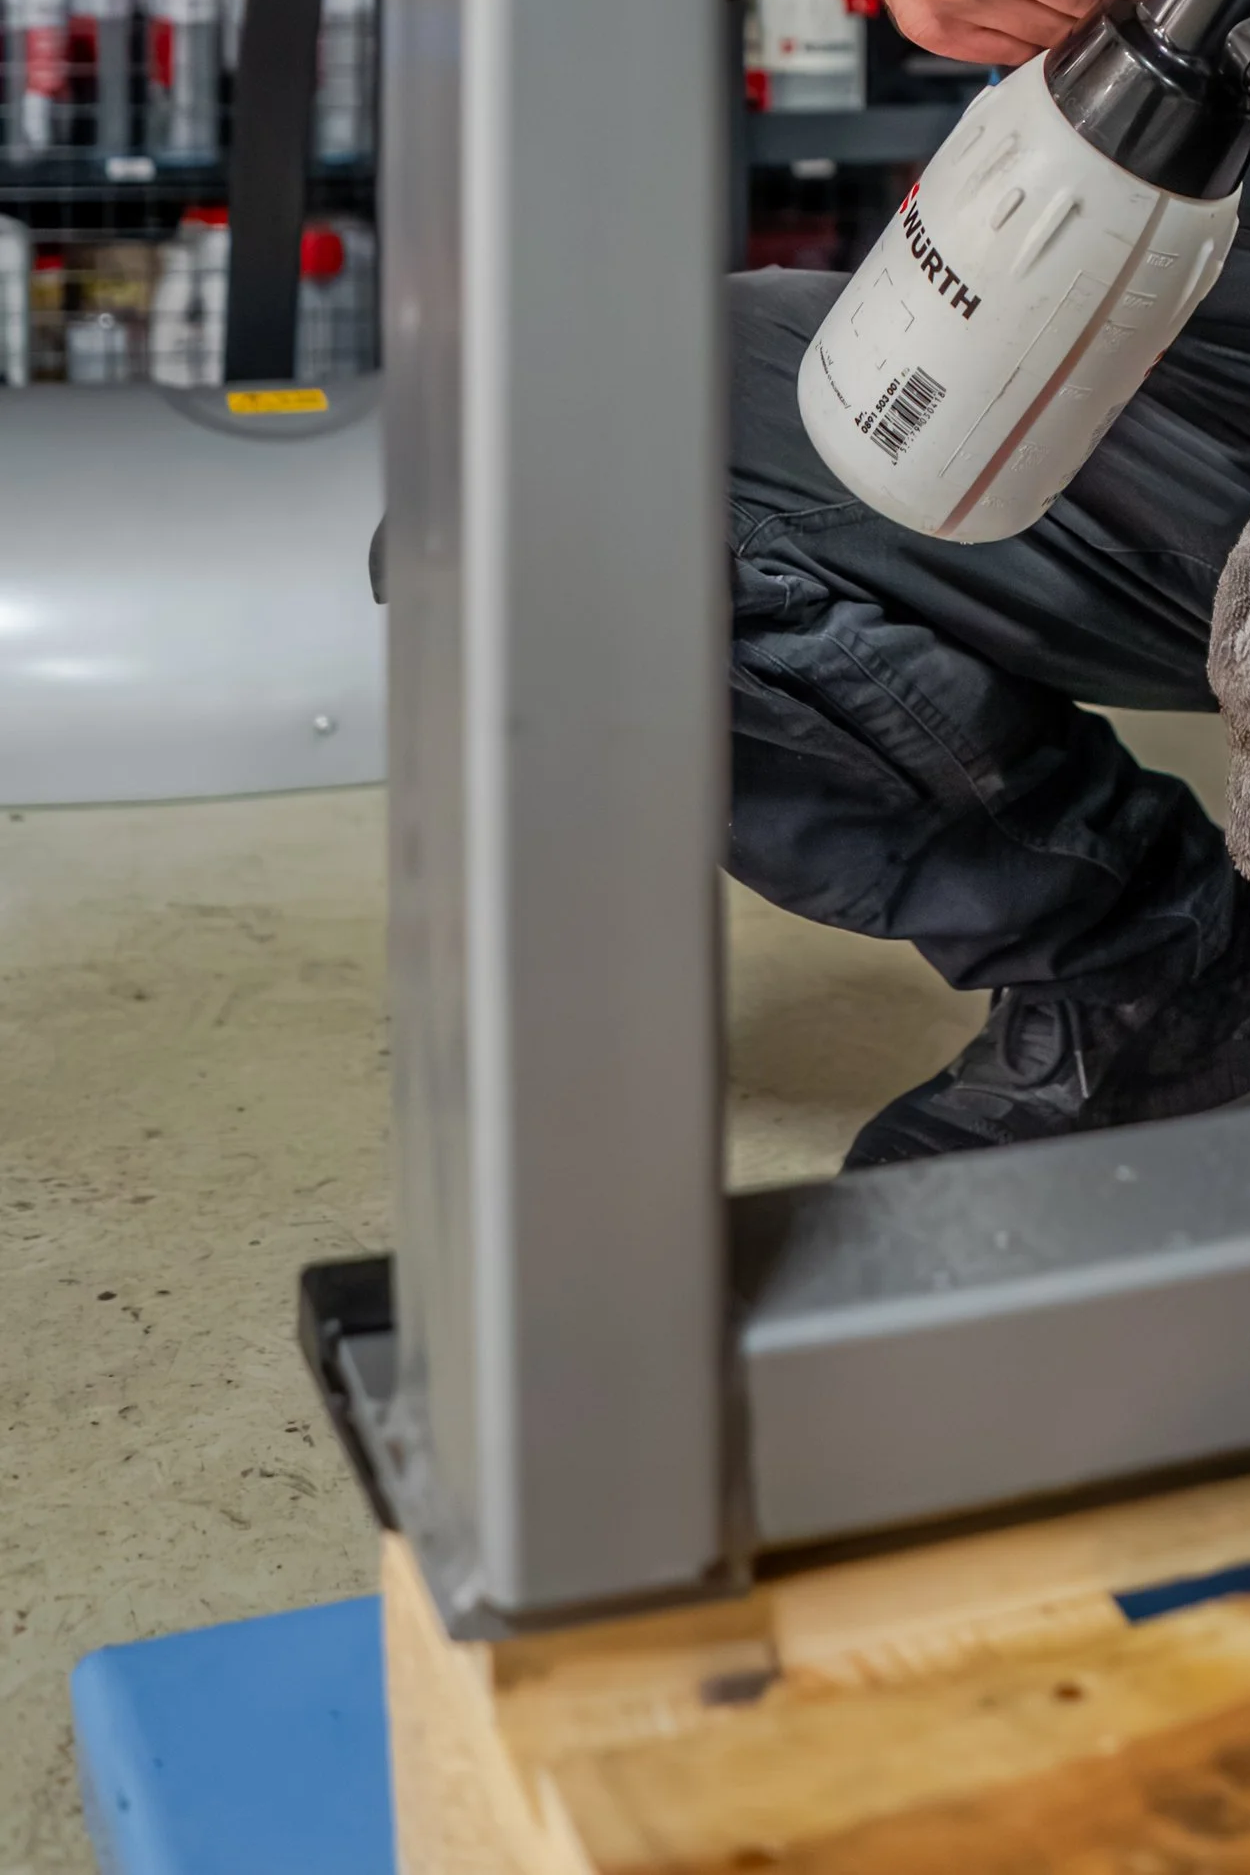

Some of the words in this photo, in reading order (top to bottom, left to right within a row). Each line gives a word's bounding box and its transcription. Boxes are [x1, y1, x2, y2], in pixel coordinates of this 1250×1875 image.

[903, 200, 982, 320] WÜRTH
[861, 412, 878, 434] 0891
[876, 394, 890, 413] 503
[886, 378, 901, 396] 001
